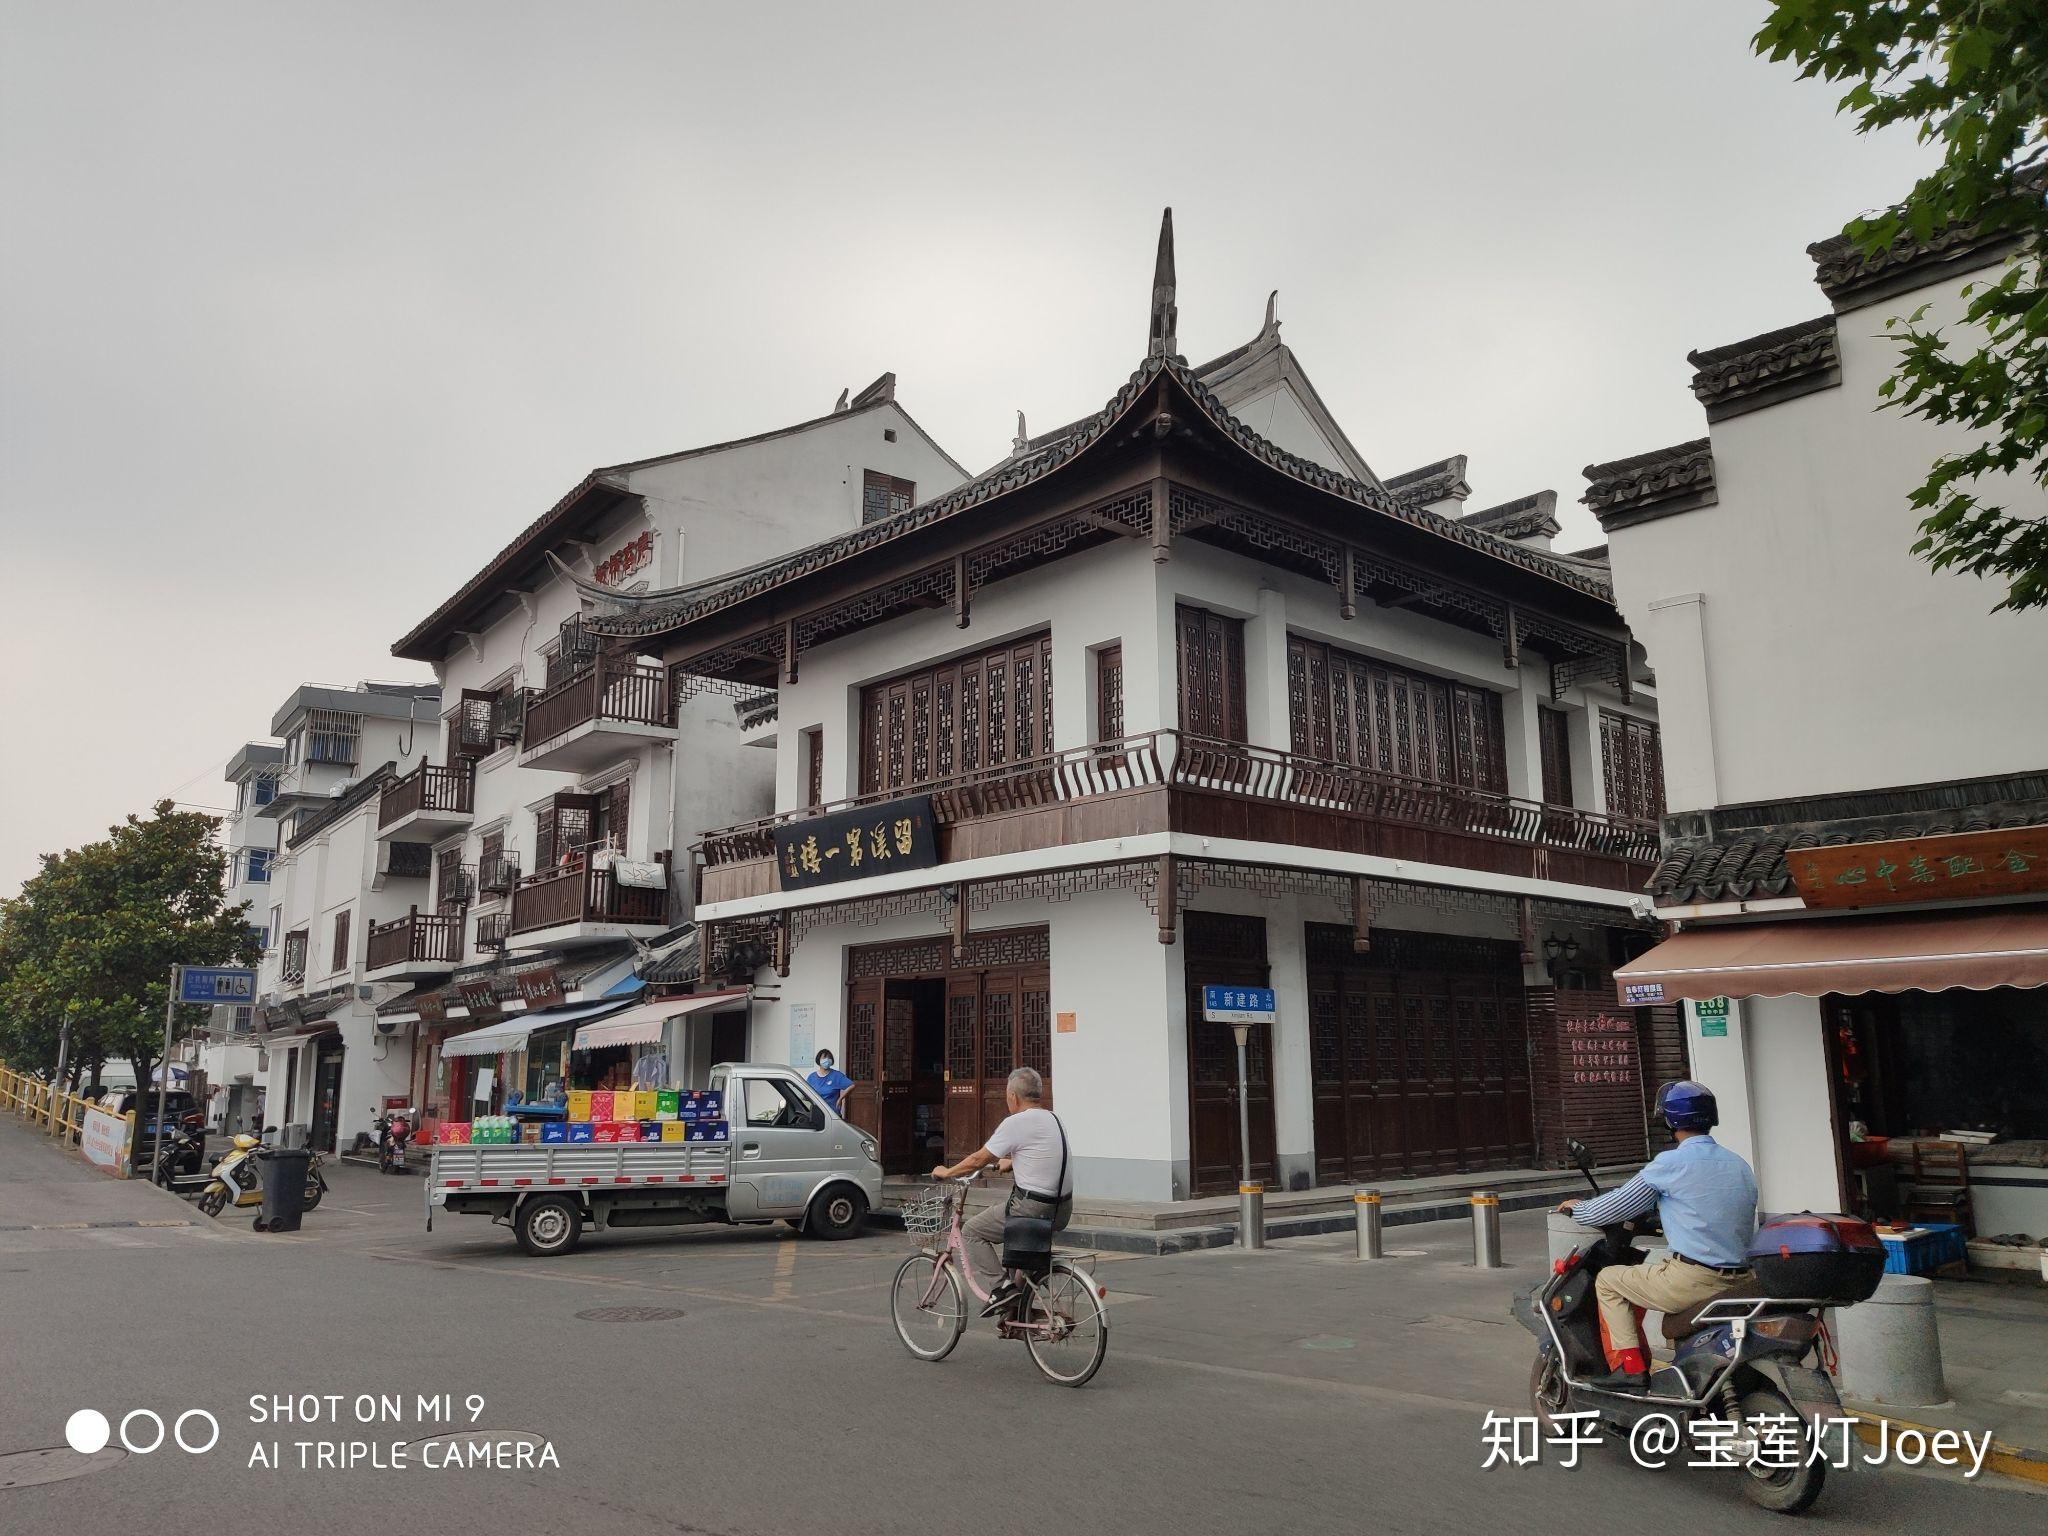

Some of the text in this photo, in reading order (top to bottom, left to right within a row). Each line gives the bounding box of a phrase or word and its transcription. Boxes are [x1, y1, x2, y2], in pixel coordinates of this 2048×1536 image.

[1224, 991, 1259, 1008] 新建路
[1211, 1011, 1216, 1019] S
